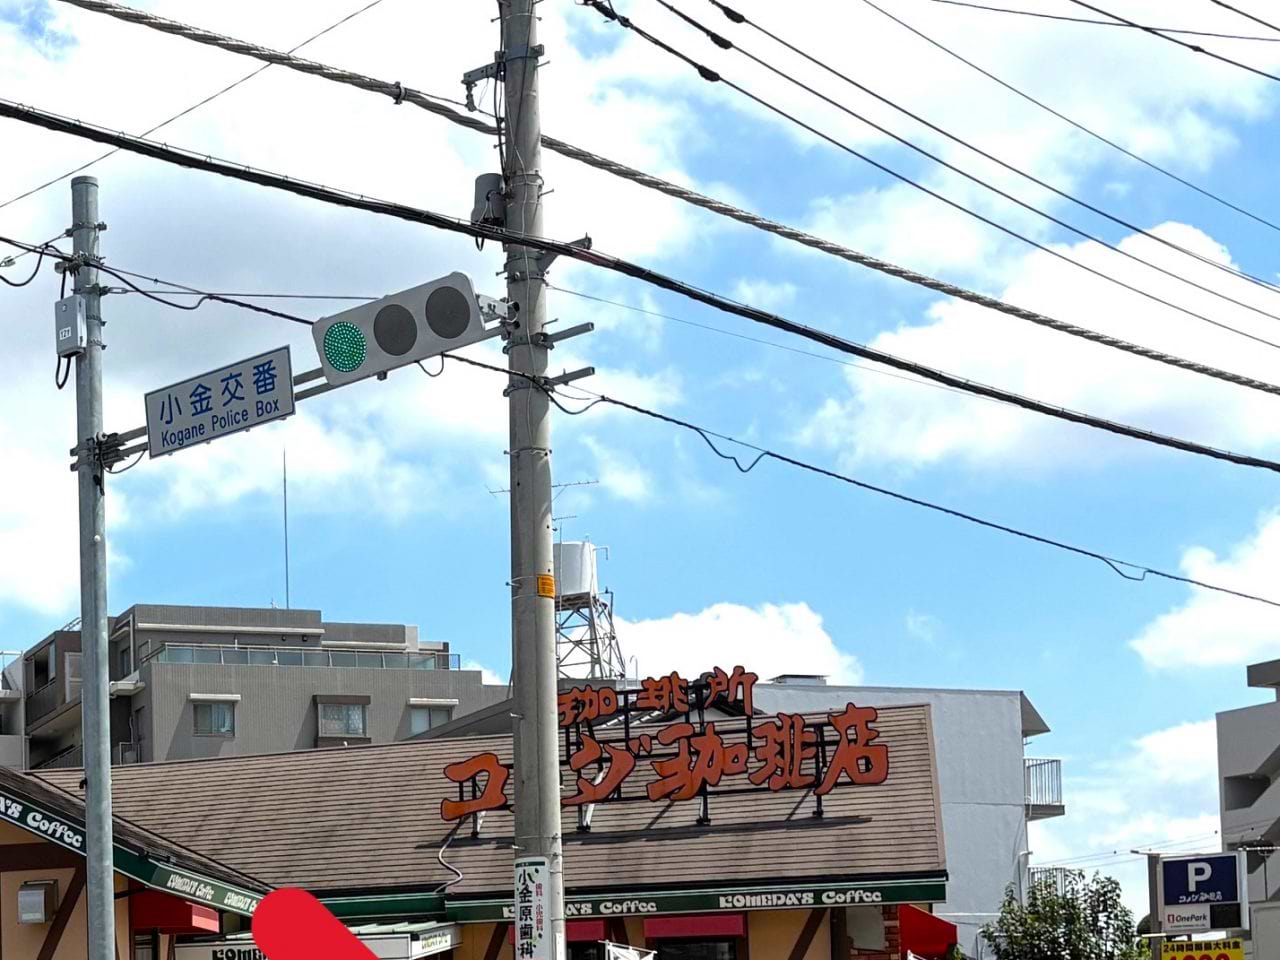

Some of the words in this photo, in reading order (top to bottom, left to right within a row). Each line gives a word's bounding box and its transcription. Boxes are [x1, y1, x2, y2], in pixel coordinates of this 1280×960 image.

[160, 360, 277, 424] 小金交番
[161, 423, 205, 447] Kogane
[211, 409, 248, 431] Police
[255, 398, 280, 417] Box
[440, 702, 889, 821] コダ珈琲店
[26, 812, 84, 848] Coffee
[1187, 862, 1212, 892] P
[519, 868, 535, 958] 小金原歯科
[599, 900, 657, 914] Coffee
[719, 892, 815, 908] KOMEDA'S
[821, 890, 882, 904] Coffee
[1176, 913, 1208, 922] OnePark
